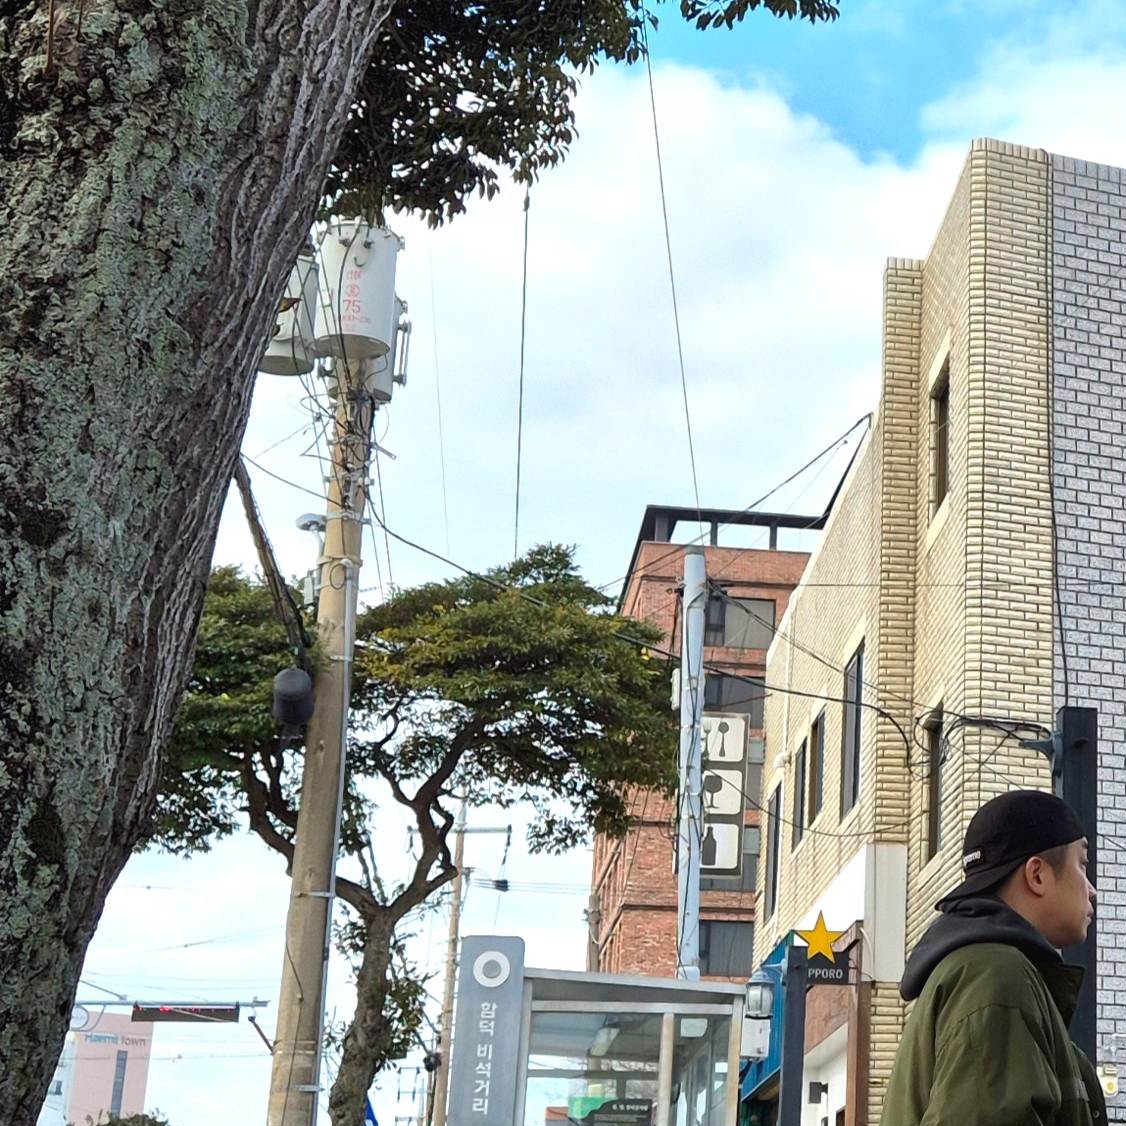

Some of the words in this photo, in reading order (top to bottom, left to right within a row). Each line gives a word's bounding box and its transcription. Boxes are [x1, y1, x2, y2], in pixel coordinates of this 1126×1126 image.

[342, 299, 361, 314] 75
[807, 968, 844, 979] PPORO
[479, 1001, 498, 1037] 함덕
[121, 1036, 146, 1047] Town
[472, 1043, 493, 1116] 비석거리
